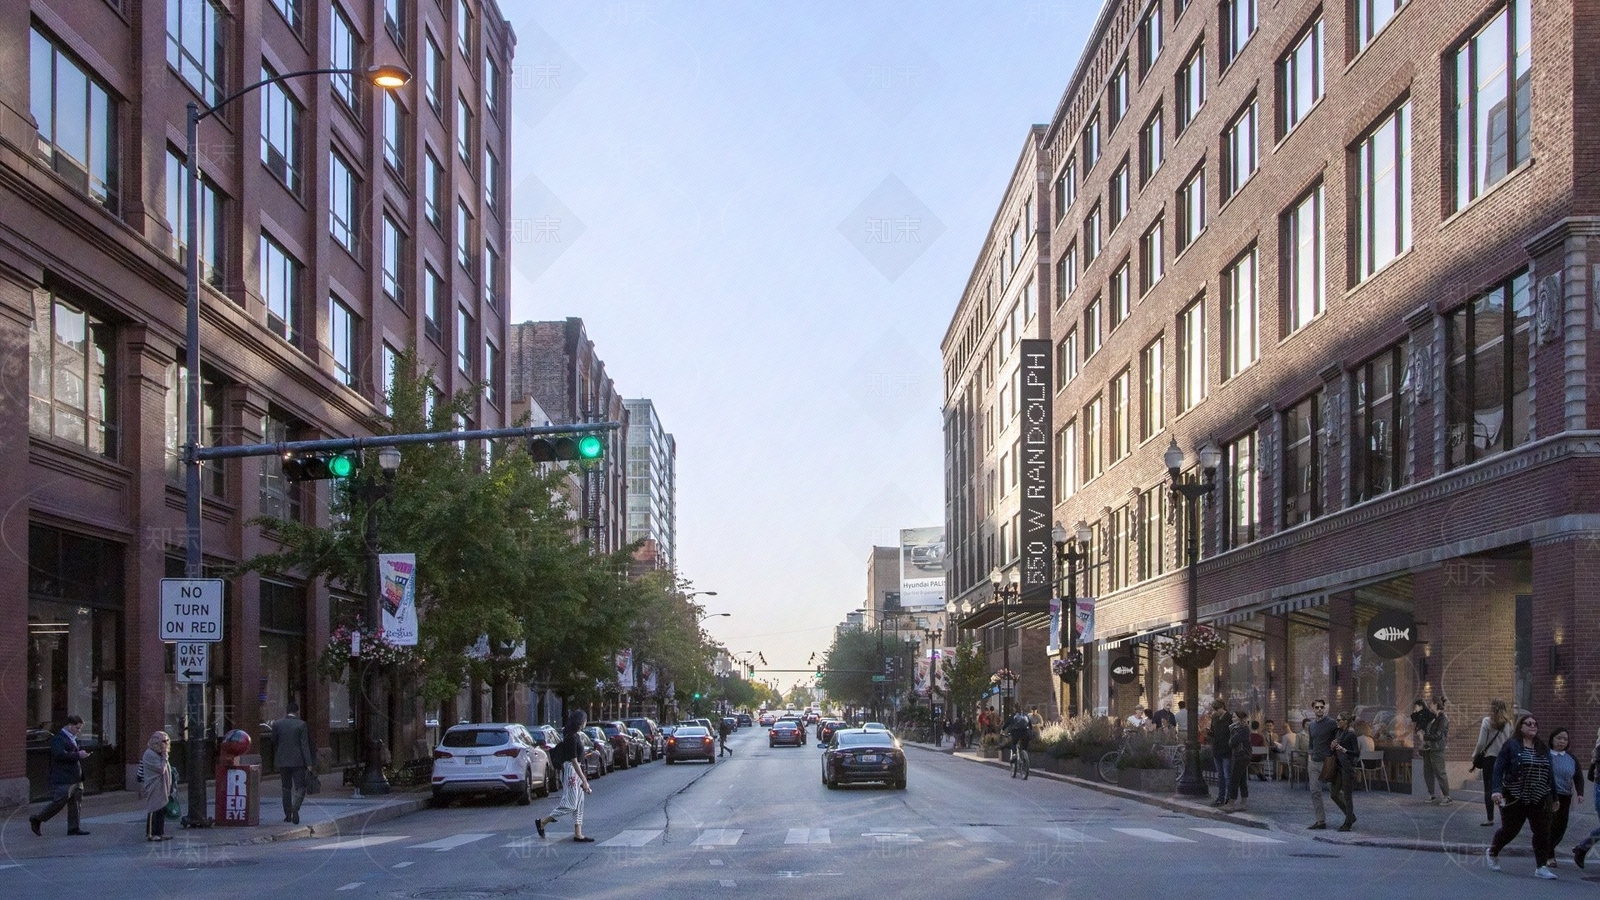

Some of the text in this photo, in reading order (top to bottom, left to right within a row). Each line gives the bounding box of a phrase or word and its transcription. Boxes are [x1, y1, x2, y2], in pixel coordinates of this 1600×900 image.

[1027, 353, 1047, 584] 550 W RANDOLPH
[903, 581, 929, 589] Hyundai
[181, 586, 202, 598] NO
[174, 604, 209, 615] TURN
[166, 621, 216, 633] ON RED
[180, 645, 204, 655] ONE
[180, 657, 205, 667] WAY
[226, 811, 246, 820] EYE
